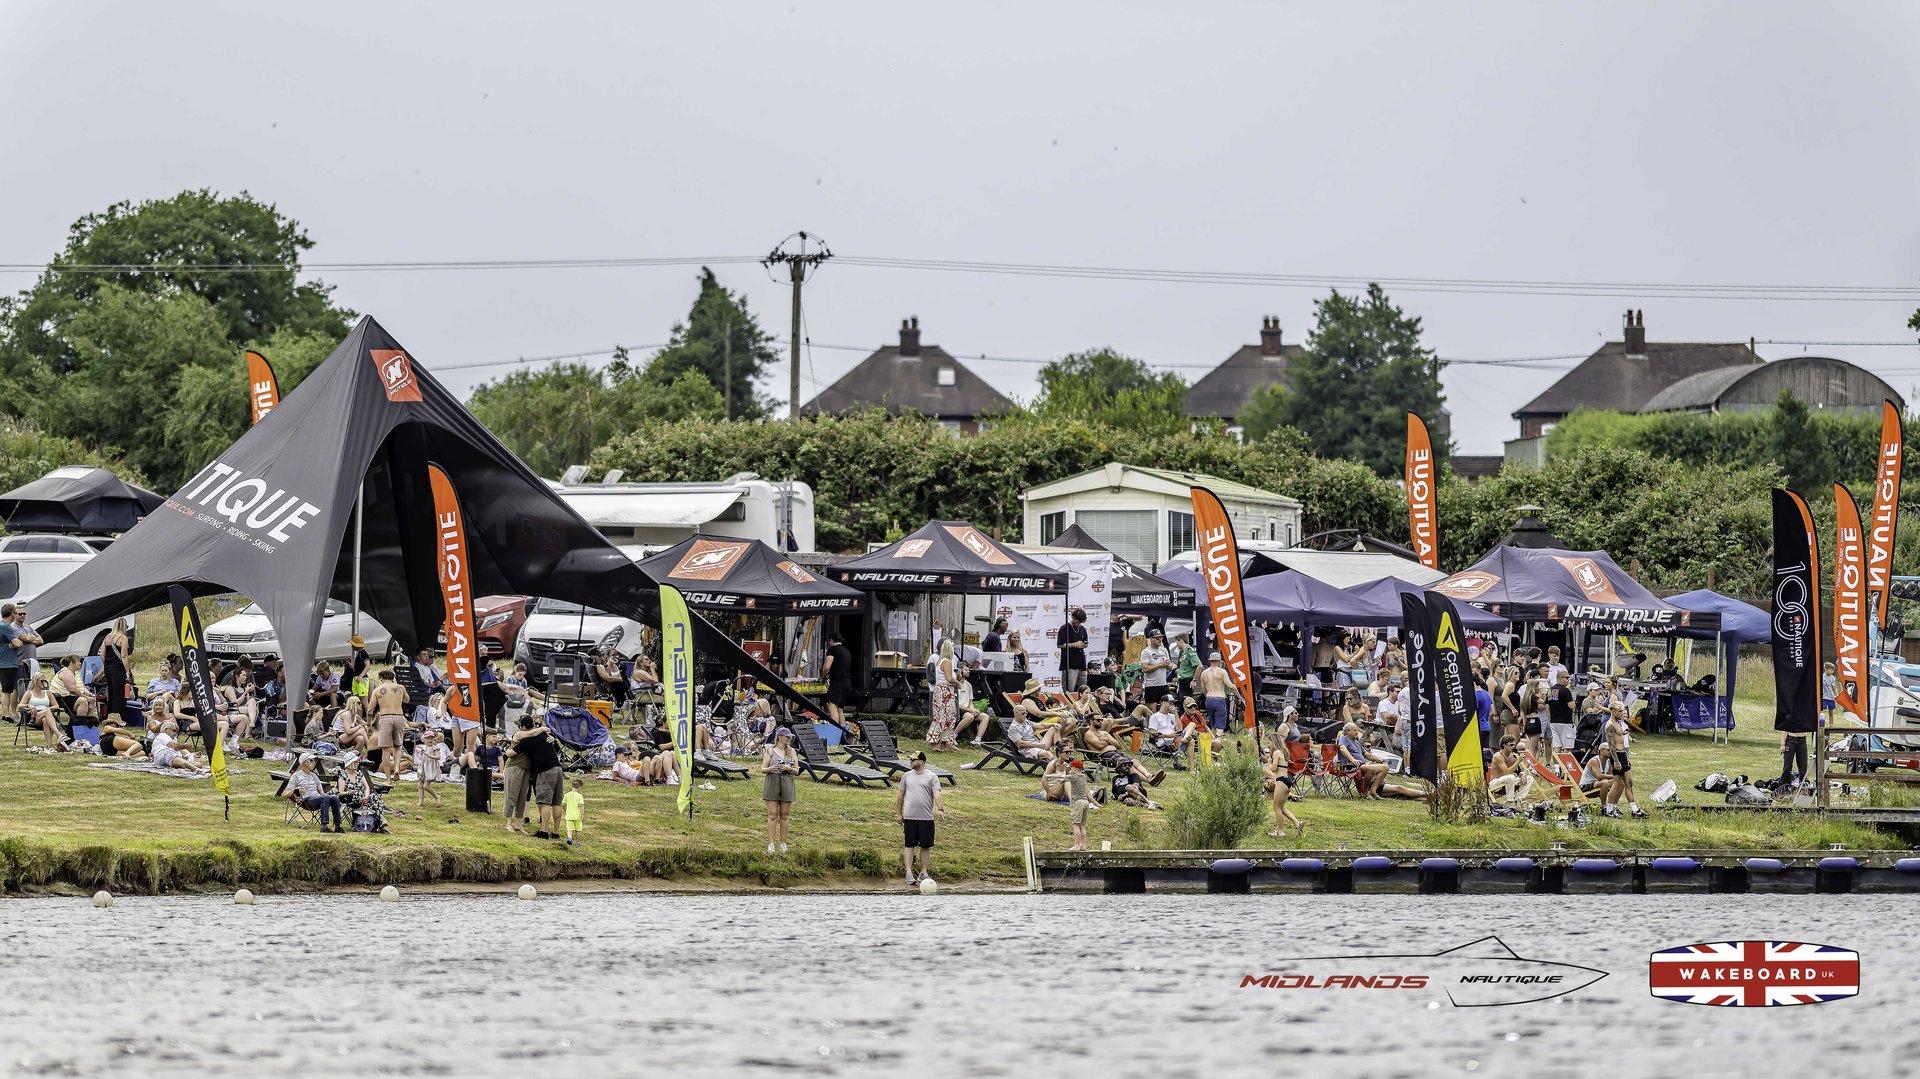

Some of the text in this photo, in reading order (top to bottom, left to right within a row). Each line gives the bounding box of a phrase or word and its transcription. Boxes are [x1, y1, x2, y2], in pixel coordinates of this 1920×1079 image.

[195, 513, 224, 529] SURFING
[226, 526, 250, 542] RIDING
[252, 538, 277, 554] SKIING
[853, 573, 937, 583] NAUTIQUE
[989, 577, 1047, 588] NAUTIQUE
[799, 598, 852, 608] NAUTIQUE
[1564, 605, 1674, 623] NAUTIQUE
[1794, 623, 1804, 668] NAUTIQUE
[187, 648, 213, 716] central
[1443, 668, 1456, 715] SOLUTIONS
[1446, 651, 1467, 715] central
